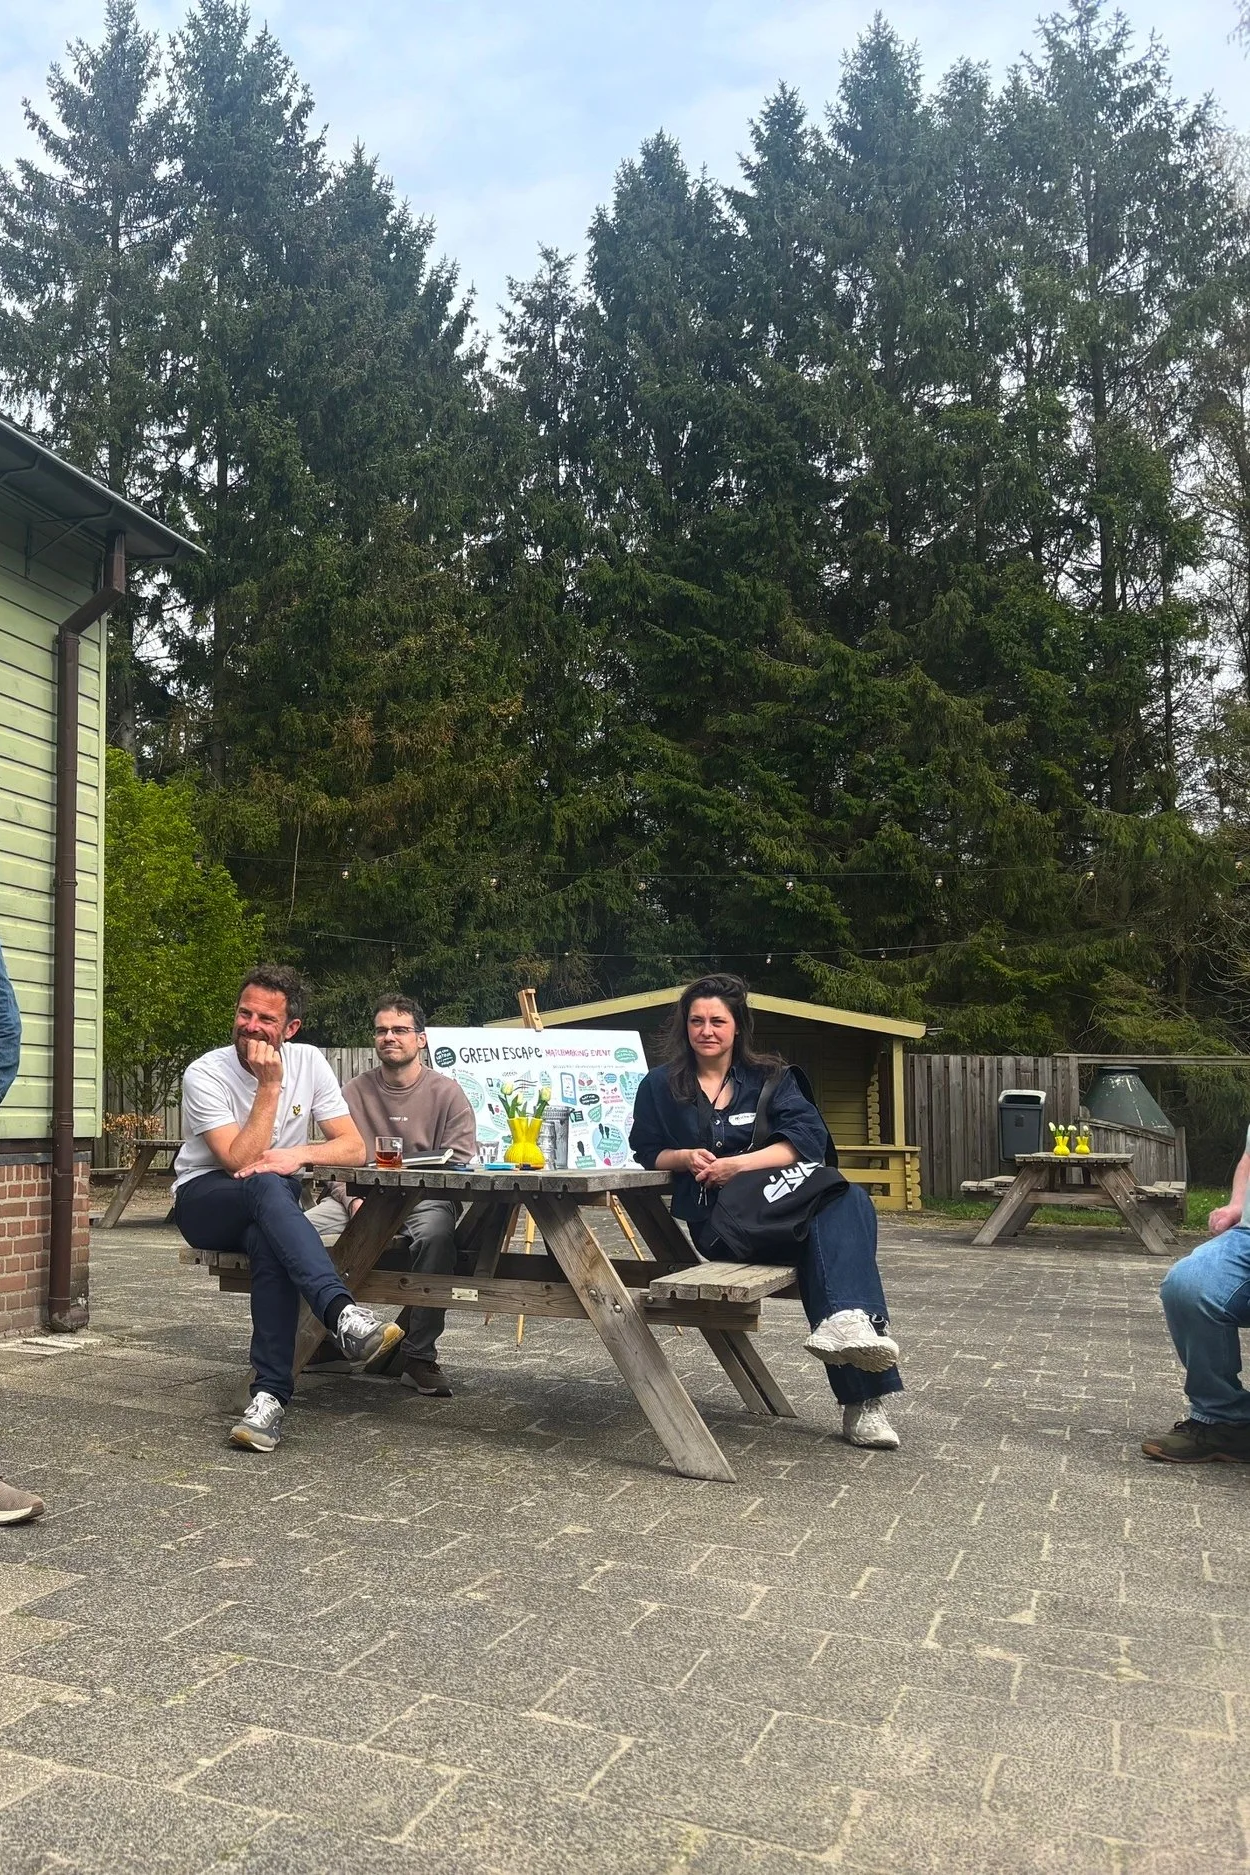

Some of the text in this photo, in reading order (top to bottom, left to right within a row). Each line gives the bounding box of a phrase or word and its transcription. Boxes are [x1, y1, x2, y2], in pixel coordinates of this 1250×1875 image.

[459, 1046, 500, 1064] GREEN
[502, 1046, 543, 1061] ESCAPE
[545, 1048, 589, 1058] MATCHMAKING
[590, 1049, 611, 1057] EVENT
